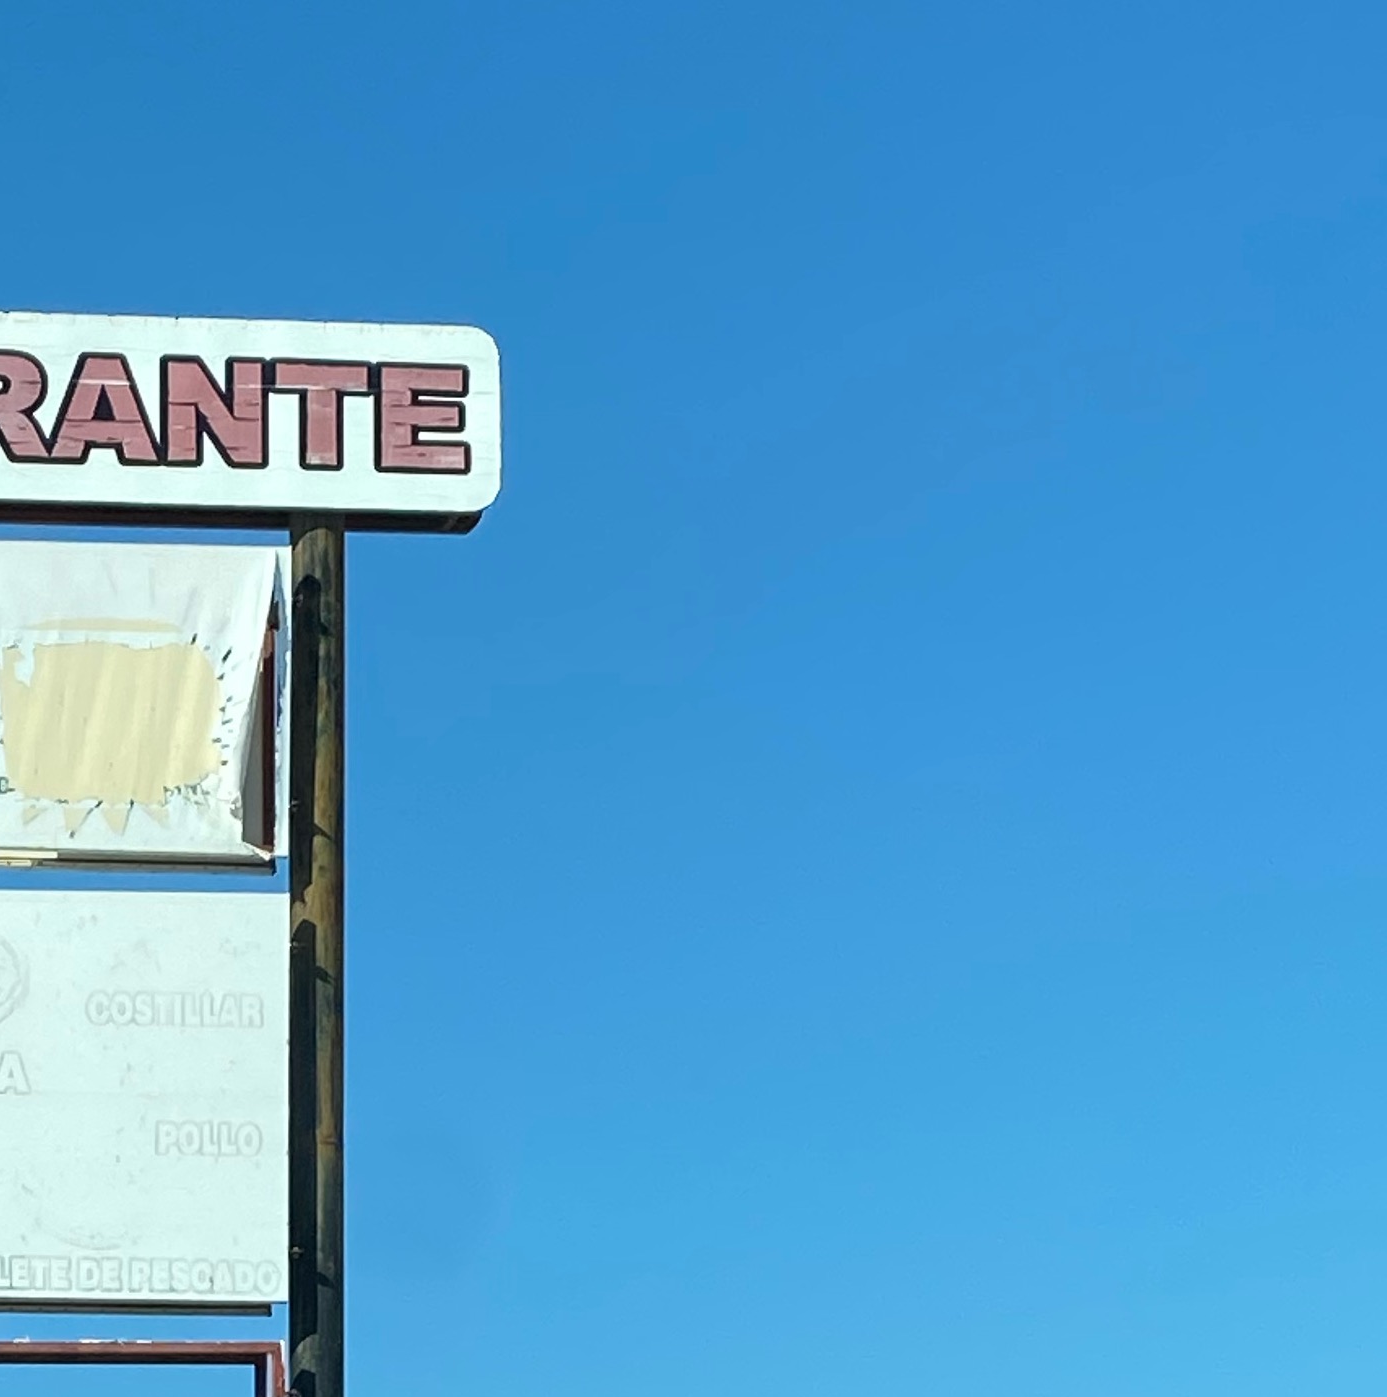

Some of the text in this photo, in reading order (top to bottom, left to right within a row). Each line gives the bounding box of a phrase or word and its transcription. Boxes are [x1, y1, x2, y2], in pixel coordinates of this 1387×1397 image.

[85, 990, 264, 1028] COSTILLAR
[154, 1119, 263, 1157] POLLO
[76, 1256, 124, 1293] DE
[128, 1257, 281, 1296] PESCADO
